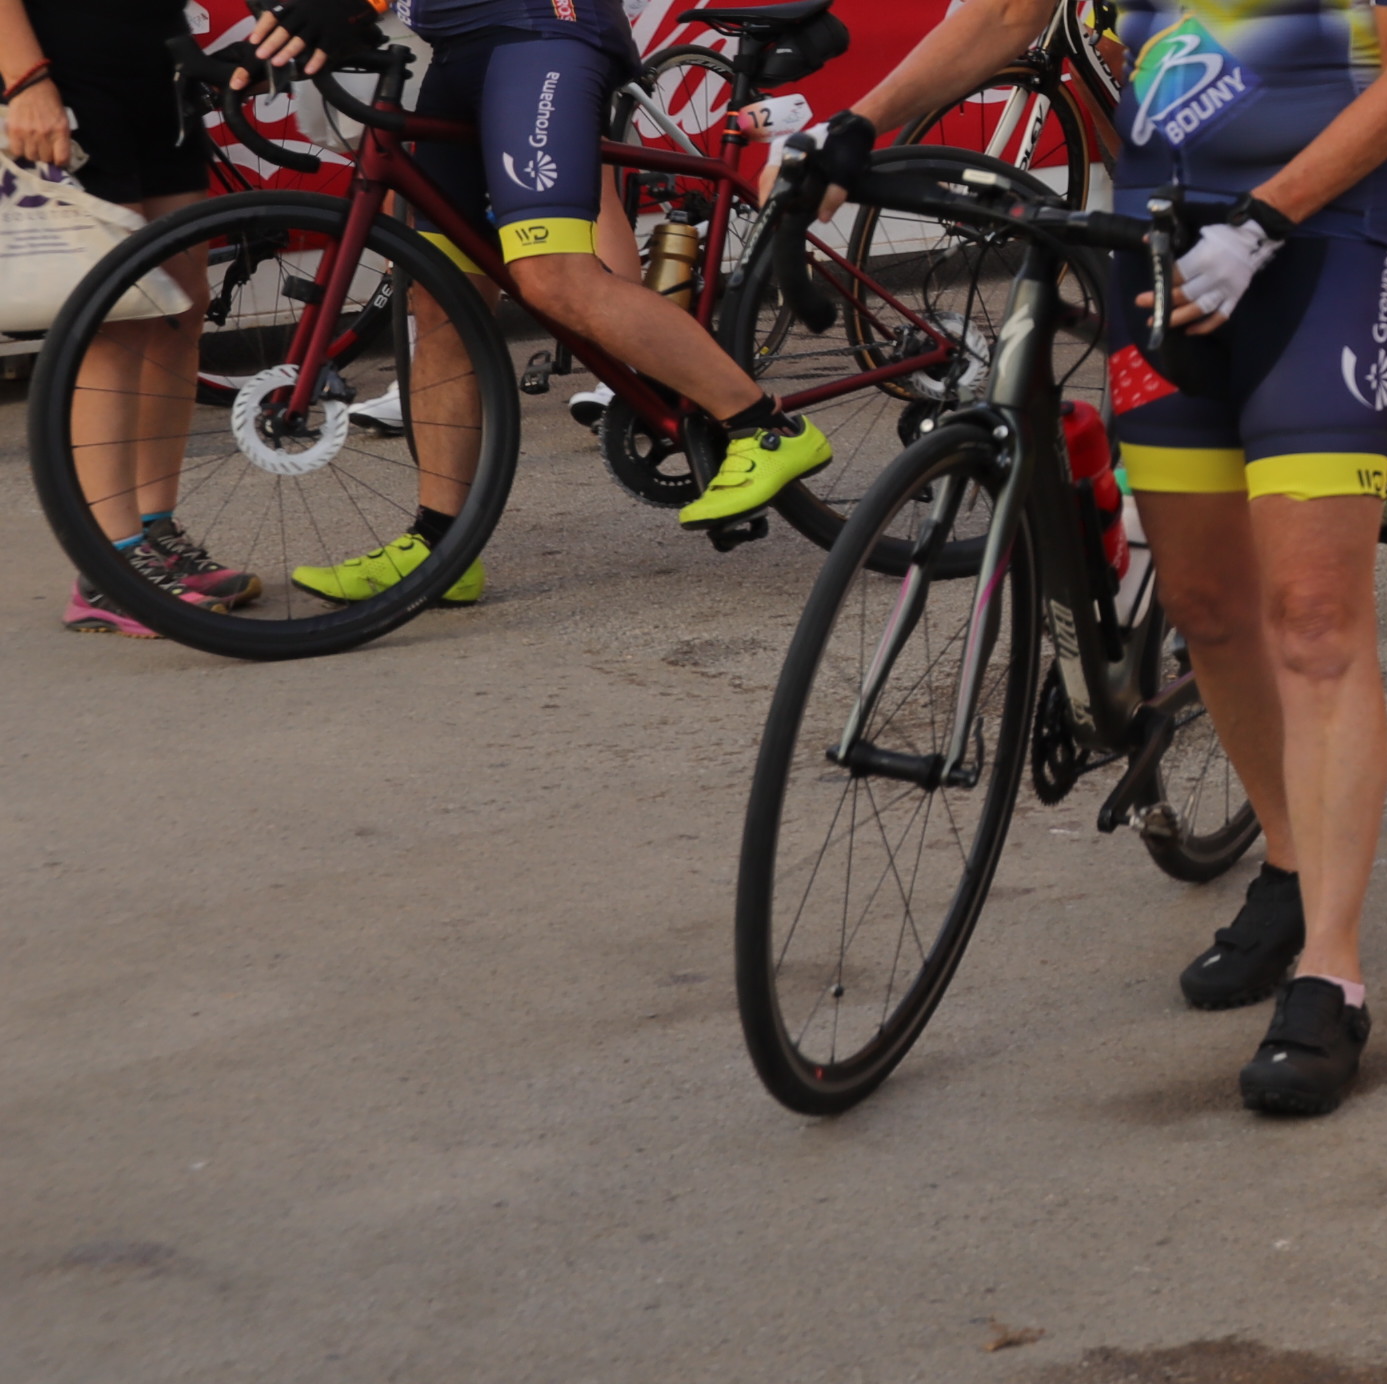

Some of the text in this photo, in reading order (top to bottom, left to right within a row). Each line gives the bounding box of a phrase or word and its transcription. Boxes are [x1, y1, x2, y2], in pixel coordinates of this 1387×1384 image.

[529, 71, 560, 148] Groupama
[748, 108, 774, 129] 12
[1164, 67, 1247, 147] BOUNY
